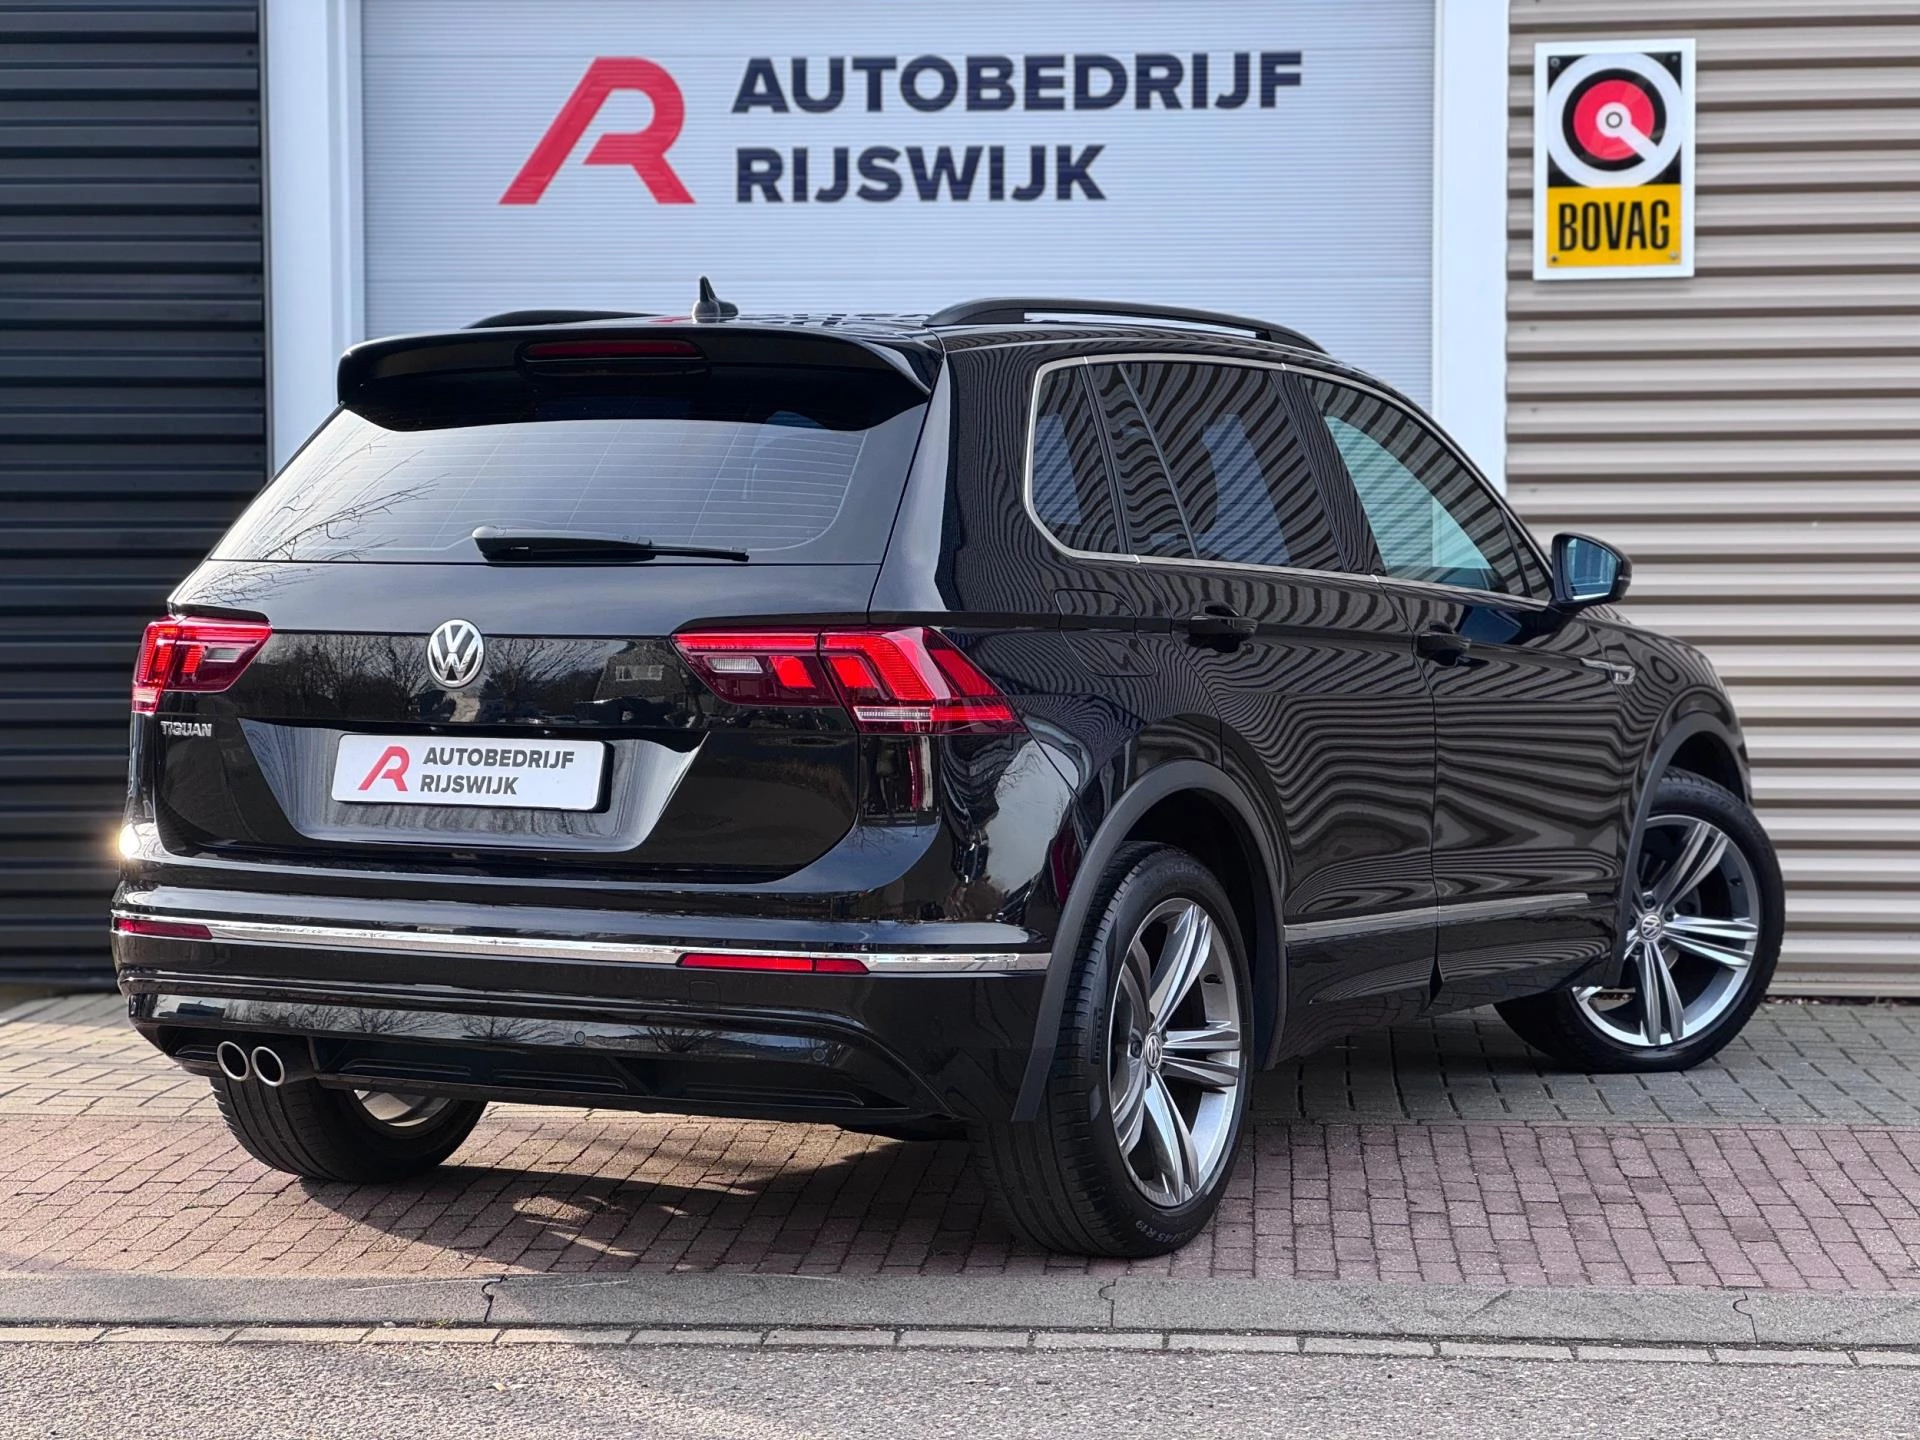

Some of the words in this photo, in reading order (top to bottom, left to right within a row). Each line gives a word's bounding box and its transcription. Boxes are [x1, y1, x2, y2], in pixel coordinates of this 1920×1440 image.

[731, 51, 1302, 114] AUTOBEDRIJF
[736, 145, 1106, 204] RIJSWIJK
[1559, 200, 1669, 251] BOVAG
[160, 720, 213, 737] TIGUAN
[422, 746, 575, 769] AUTOBEDRIJF
[420, 774, 519, 795] RIJSWIJK
